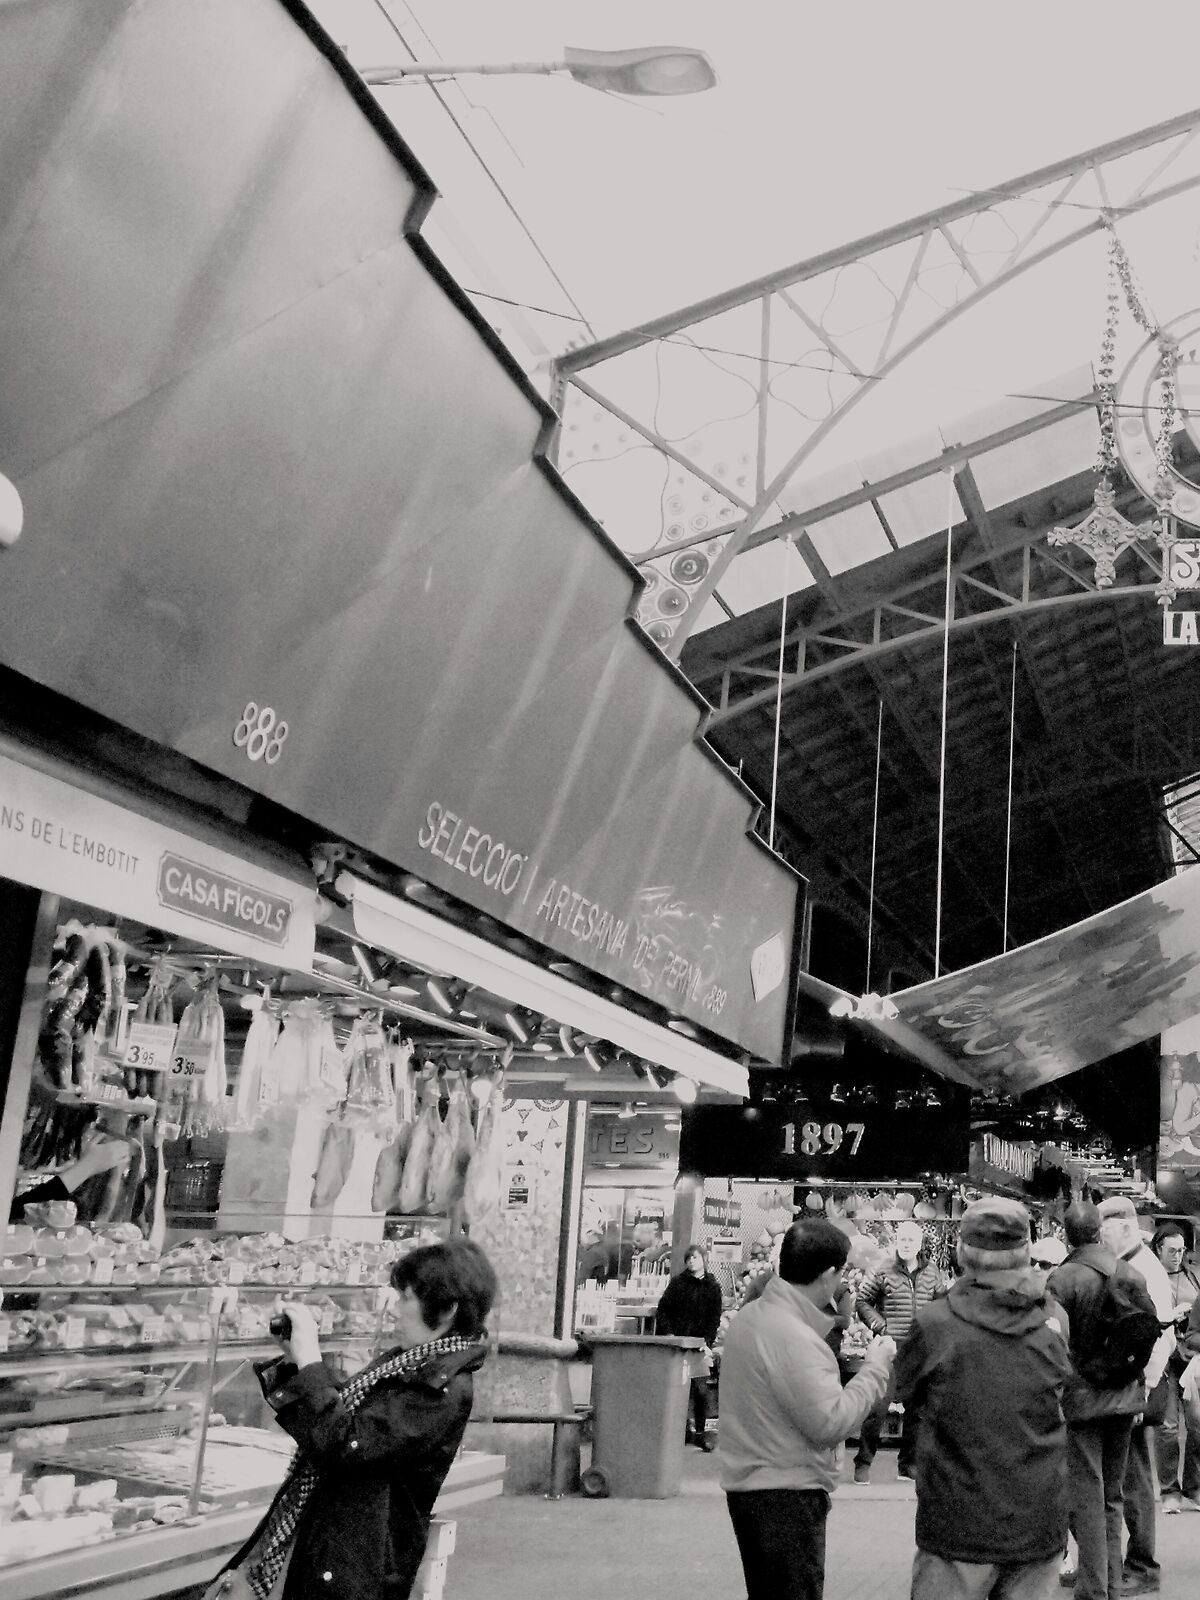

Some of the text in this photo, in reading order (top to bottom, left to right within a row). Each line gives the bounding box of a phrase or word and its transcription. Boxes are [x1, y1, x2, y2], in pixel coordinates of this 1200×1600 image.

[1165, 611, 1199, 644] LA
[233, 701, 289, 765] 888
[31, 818, 54, 845] DE
[59, 827, 139, 876] L'EMBOTIT
[165, 867, 220, 910] CASA
[781, 1121, 867, 1157] 1897
